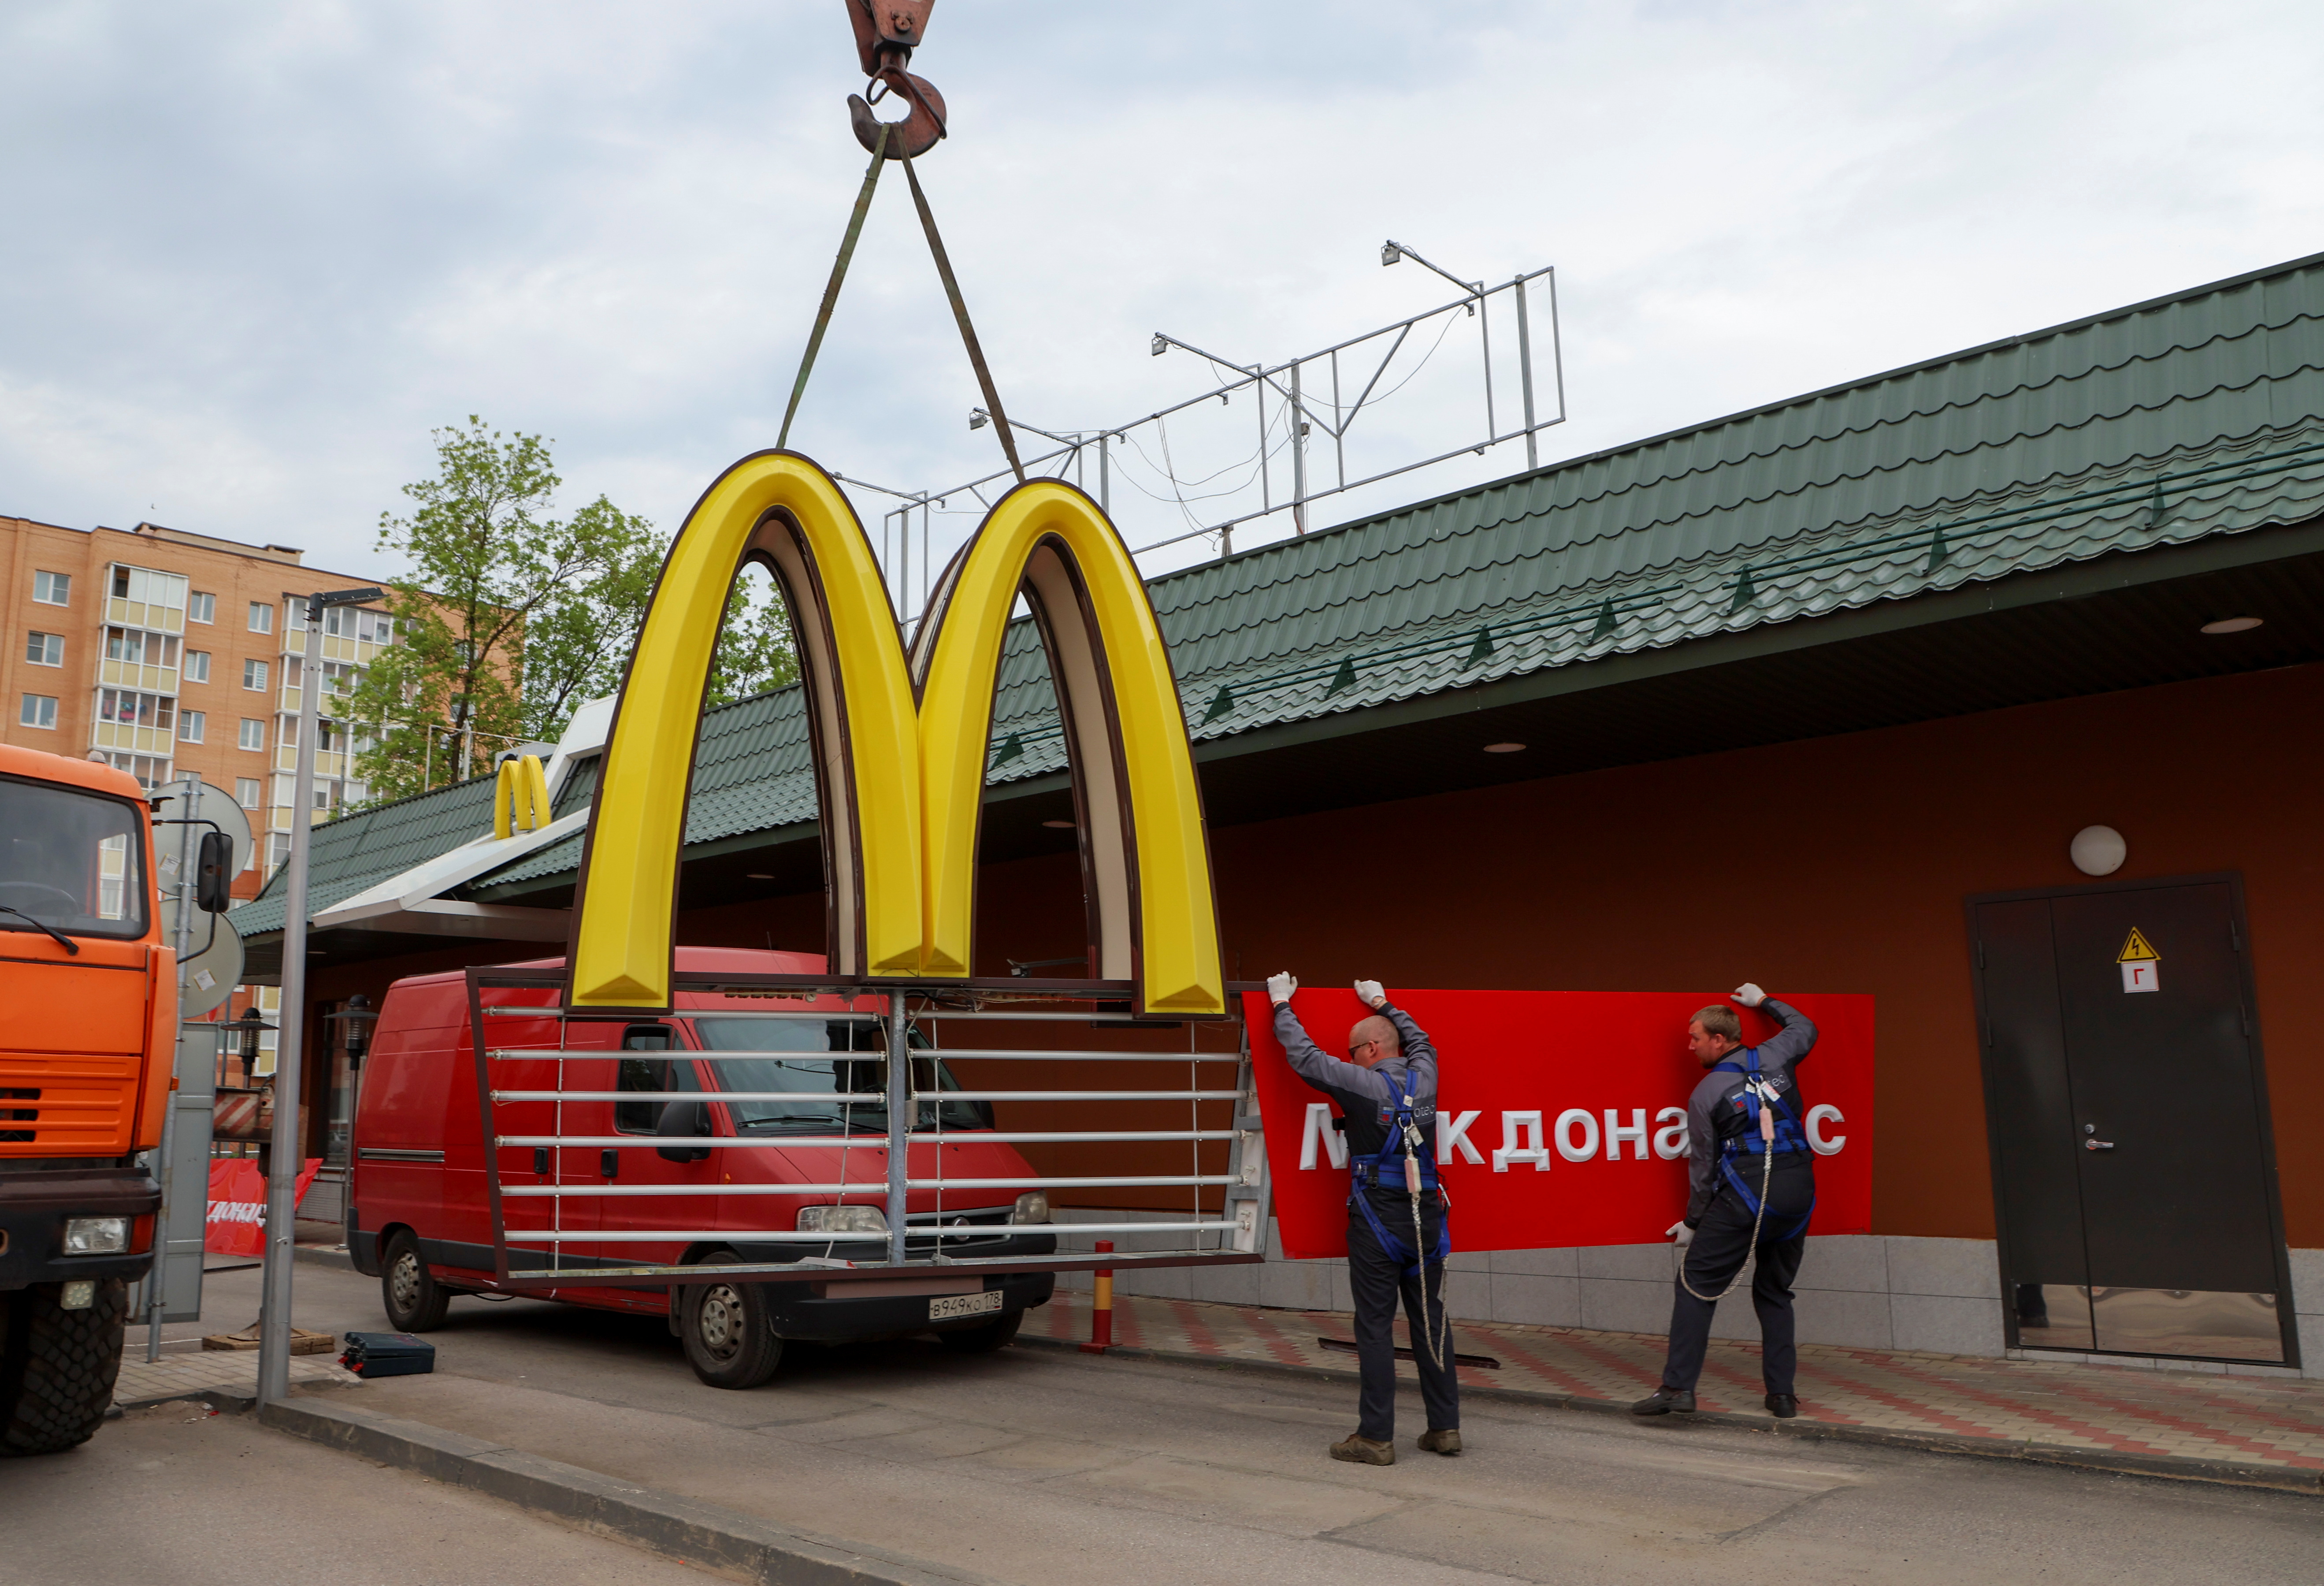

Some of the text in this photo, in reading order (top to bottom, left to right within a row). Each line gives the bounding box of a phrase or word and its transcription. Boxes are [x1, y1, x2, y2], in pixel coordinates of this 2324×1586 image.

[2134, 968, 2144, 984] Г
[1299, 1103, 1846, 1172] Мкдонас
[984, 1292, 999, 1306] 178
